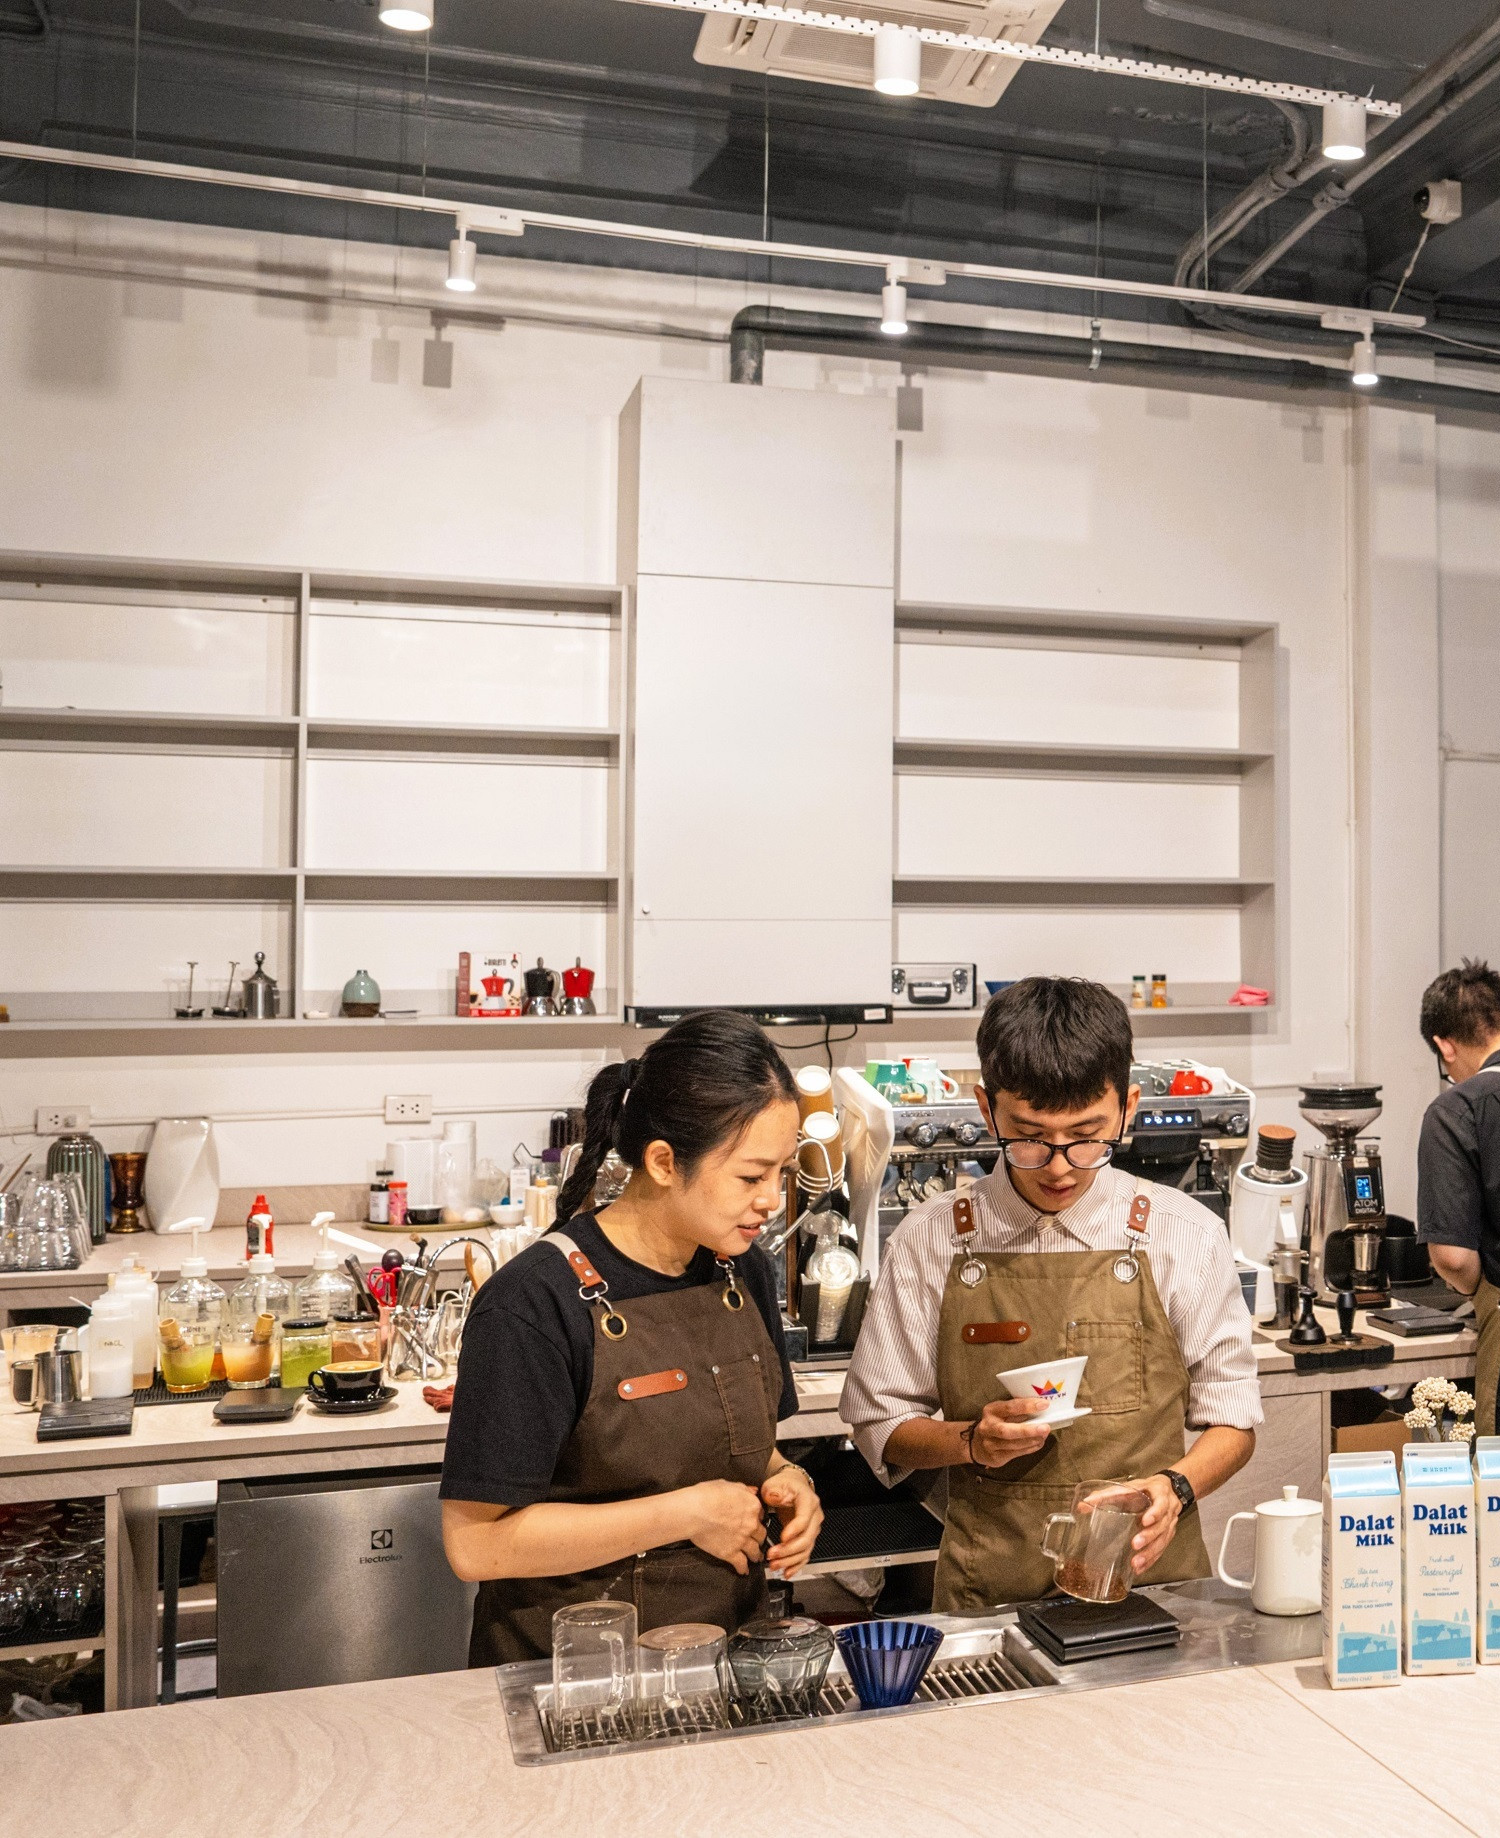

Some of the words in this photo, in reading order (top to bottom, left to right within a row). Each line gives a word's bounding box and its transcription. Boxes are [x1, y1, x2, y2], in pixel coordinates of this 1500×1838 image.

[1354, 1199, 1378, 1208] ATOM
[1413, 1504, 1468, 1521] Dalat
[1339, 1514, 1395, 1532] Dalat
[1429, 1523, 1468, 1536] Milk
[1355, 1533, 1395, 1547] Milk
[359, 1554, 403, 1564] Electrolux
